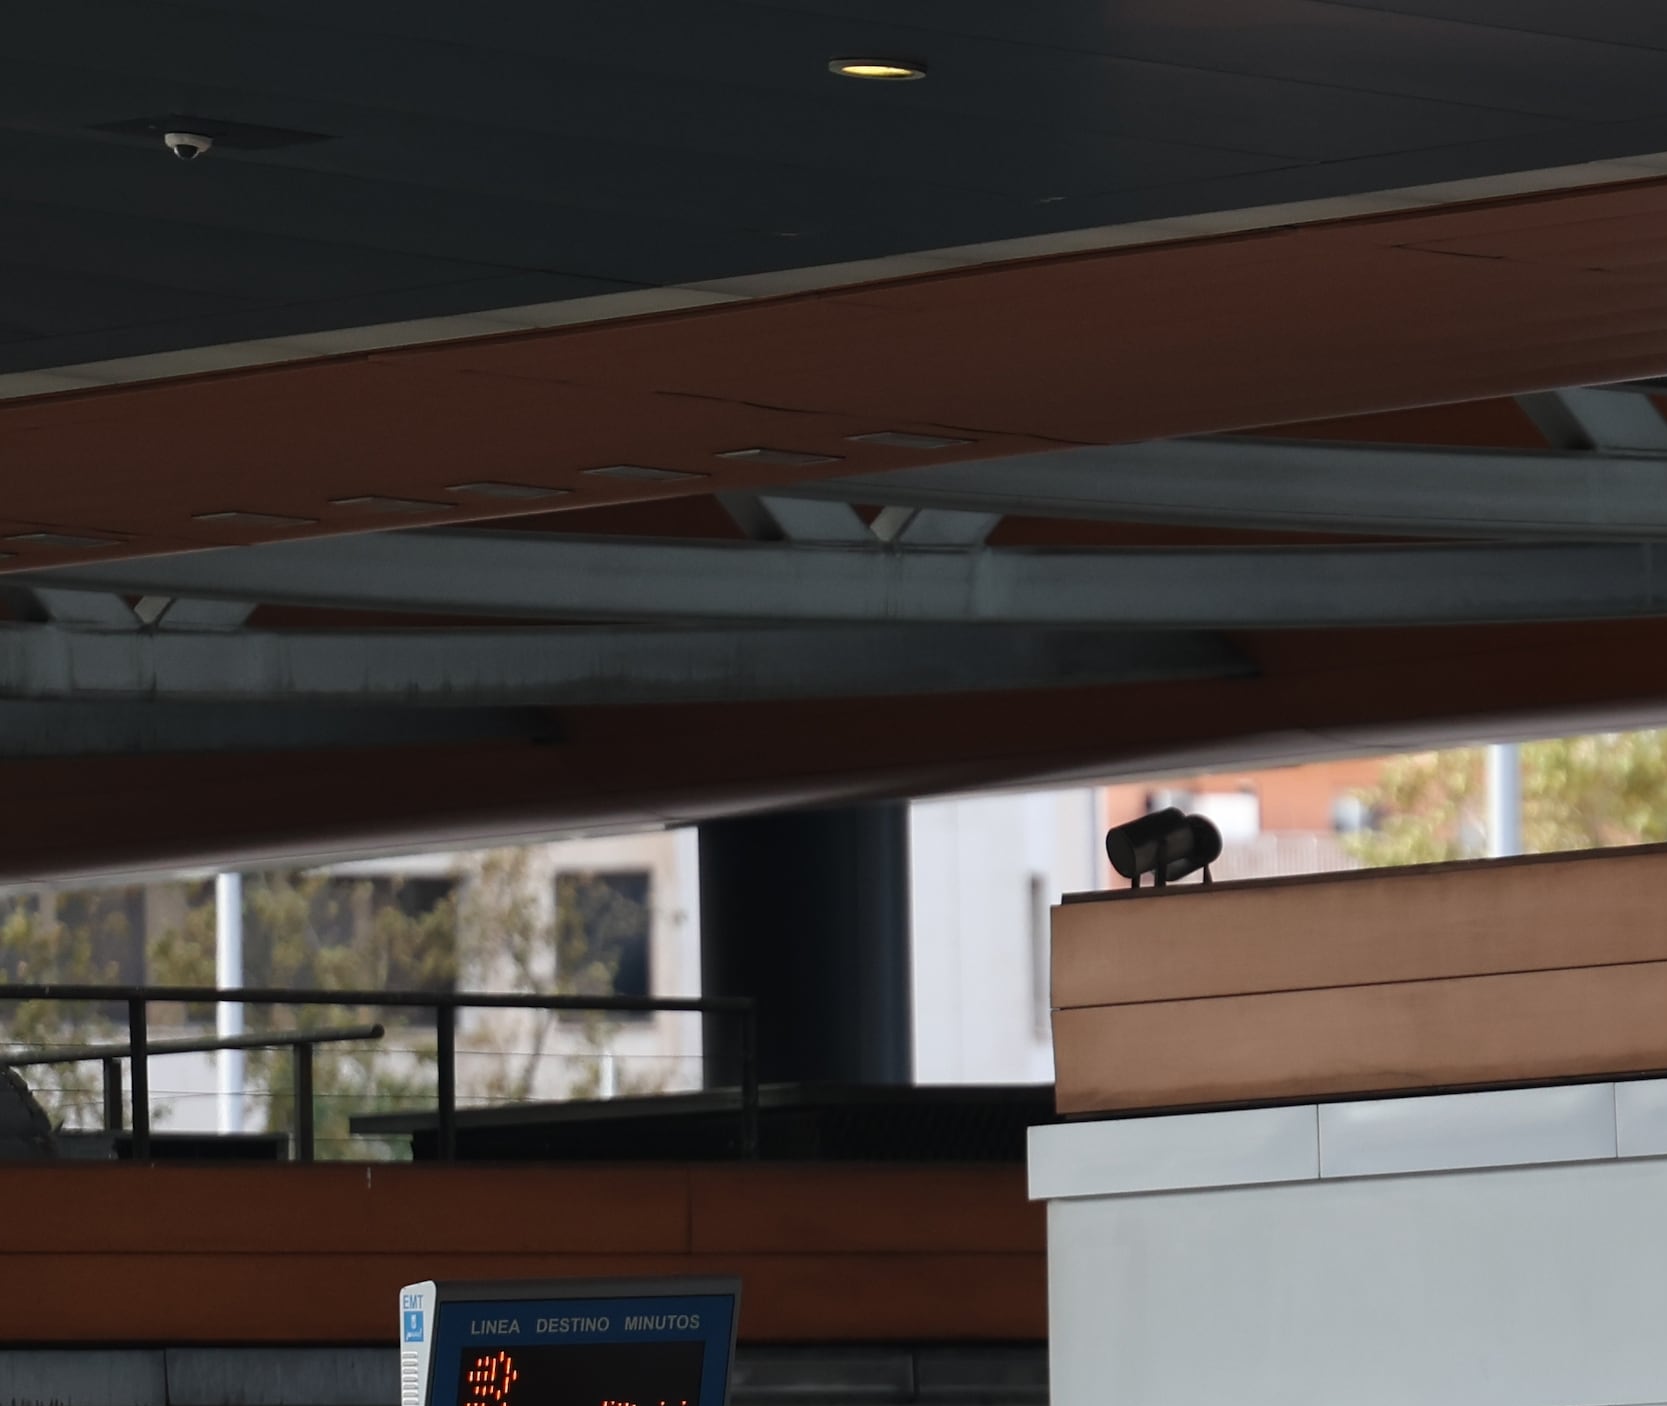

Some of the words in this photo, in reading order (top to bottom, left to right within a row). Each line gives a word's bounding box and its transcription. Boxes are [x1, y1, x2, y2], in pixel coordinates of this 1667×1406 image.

[403, 1294, 424, 1309] EMT
[471, 1320, 520, 1335] LINEA
[536, 1317, 610, 1333] DESTINO
[625, 1315, 700, 1331] MINUTOS
